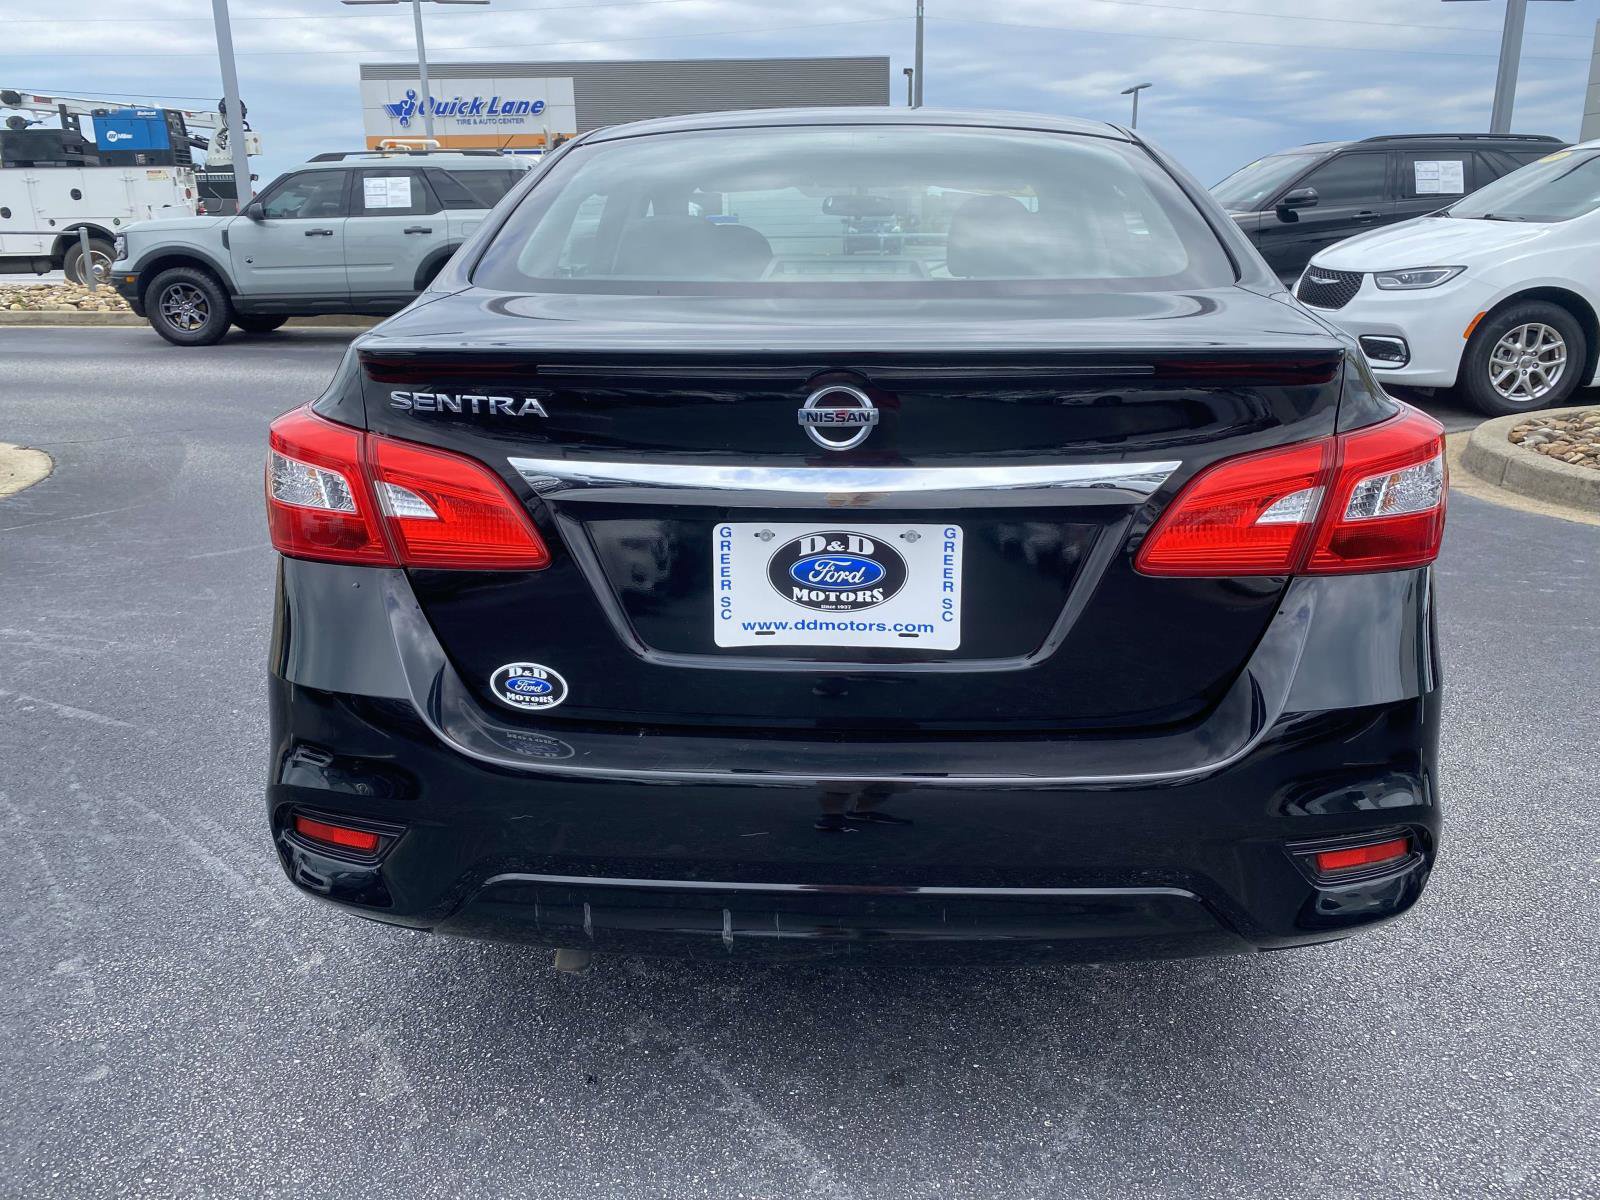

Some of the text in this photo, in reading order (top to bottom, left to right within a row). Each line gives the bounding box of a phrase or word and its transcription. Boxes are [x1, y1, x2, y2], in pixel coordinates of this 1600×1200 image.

[418, 96, 545, 116] Quick Lane
[390, 390, 549, 418] SENTRA
[806, 411, 871, 423] NISSAN
[798, 534, 875, 556] D&D
[719, 526, 732, 620] GREER SC
[808, 559, 866, 583] Ford
[942, 528, 957, 622] GREER SC
[792, 586, 884, 603] MOTORS
[741, 619, 935, 634] www.ddmotors.com
[508, 667, 547, 679] D&D
[514, 679, 543, 693] Ford
[505, 692, 554, 703] MOTORS
